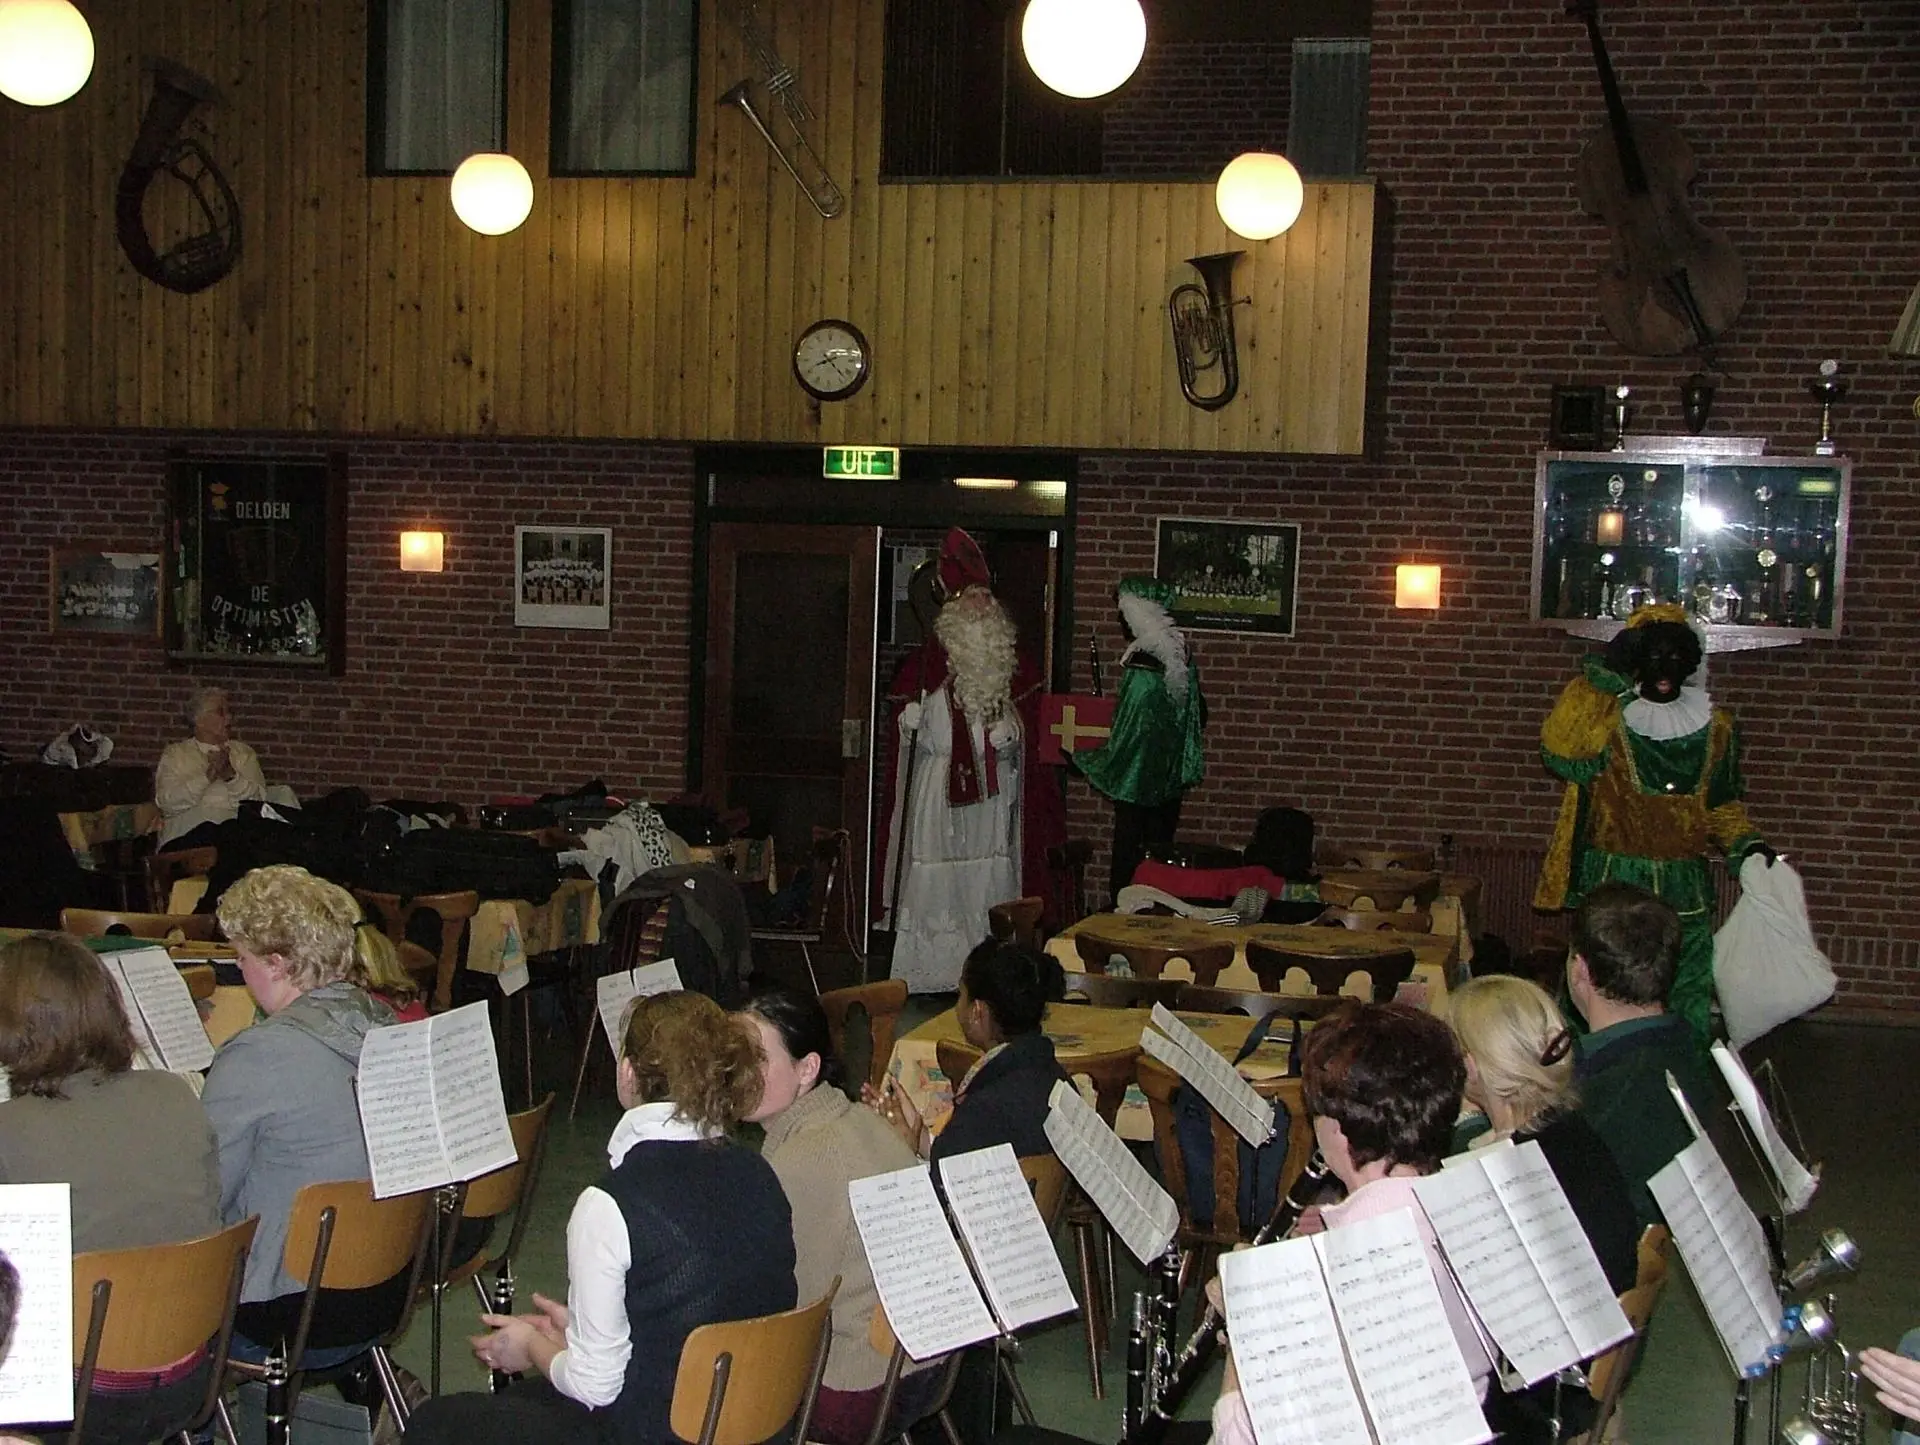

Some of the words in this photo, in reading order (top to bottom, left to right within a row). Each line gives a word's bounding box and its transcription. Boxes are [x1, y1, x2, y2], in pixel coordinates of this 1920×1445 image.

[842, 450, 877, 474] UIT
[235, 500, 292, 520] DELDEN
[250, 585, 270, 603] DE
